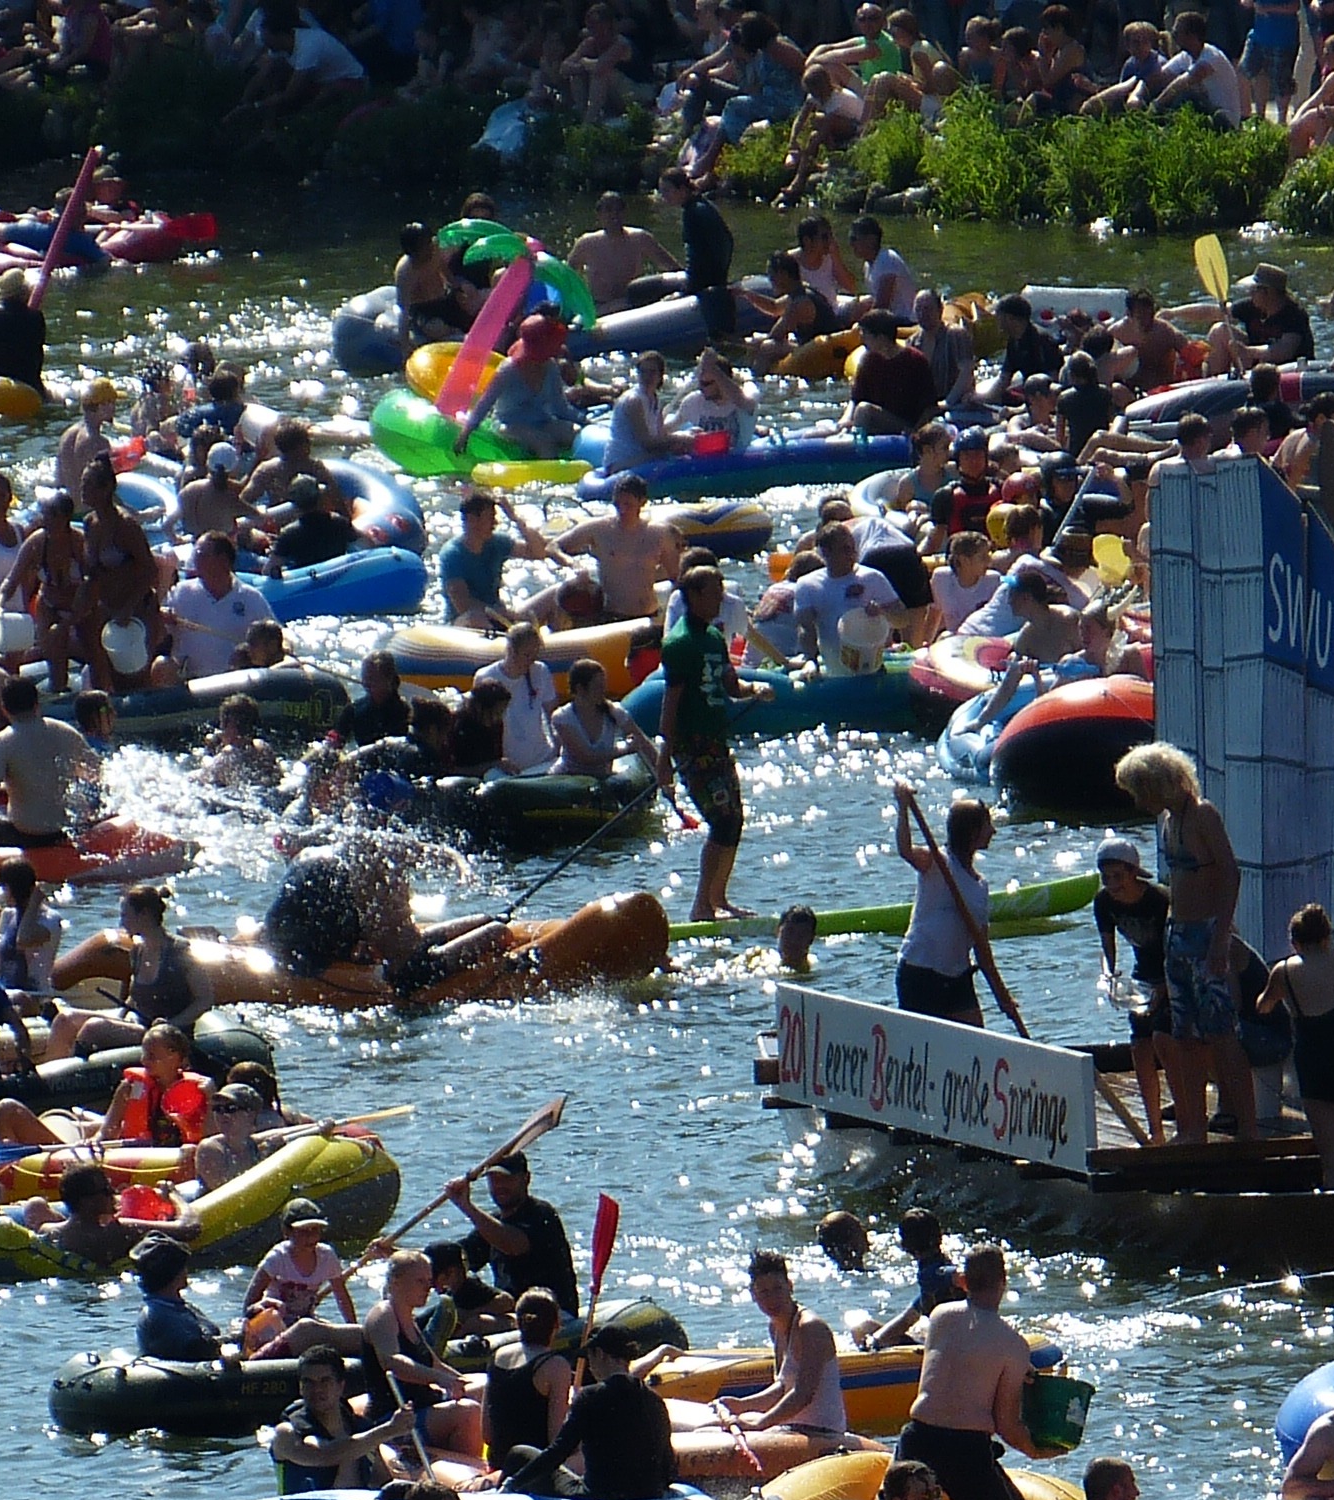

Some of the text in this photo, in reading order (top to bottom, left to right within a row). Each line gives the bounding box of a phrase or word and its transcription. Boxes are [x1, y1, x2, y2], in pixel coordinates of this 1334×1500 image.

[1268, 551, 1333, 669] SWU
[812, 1011, 869, 1098] Leerer
[942, 1056, 990, 1134] große
[993, 1057, 1068, 1159] Sprünge
